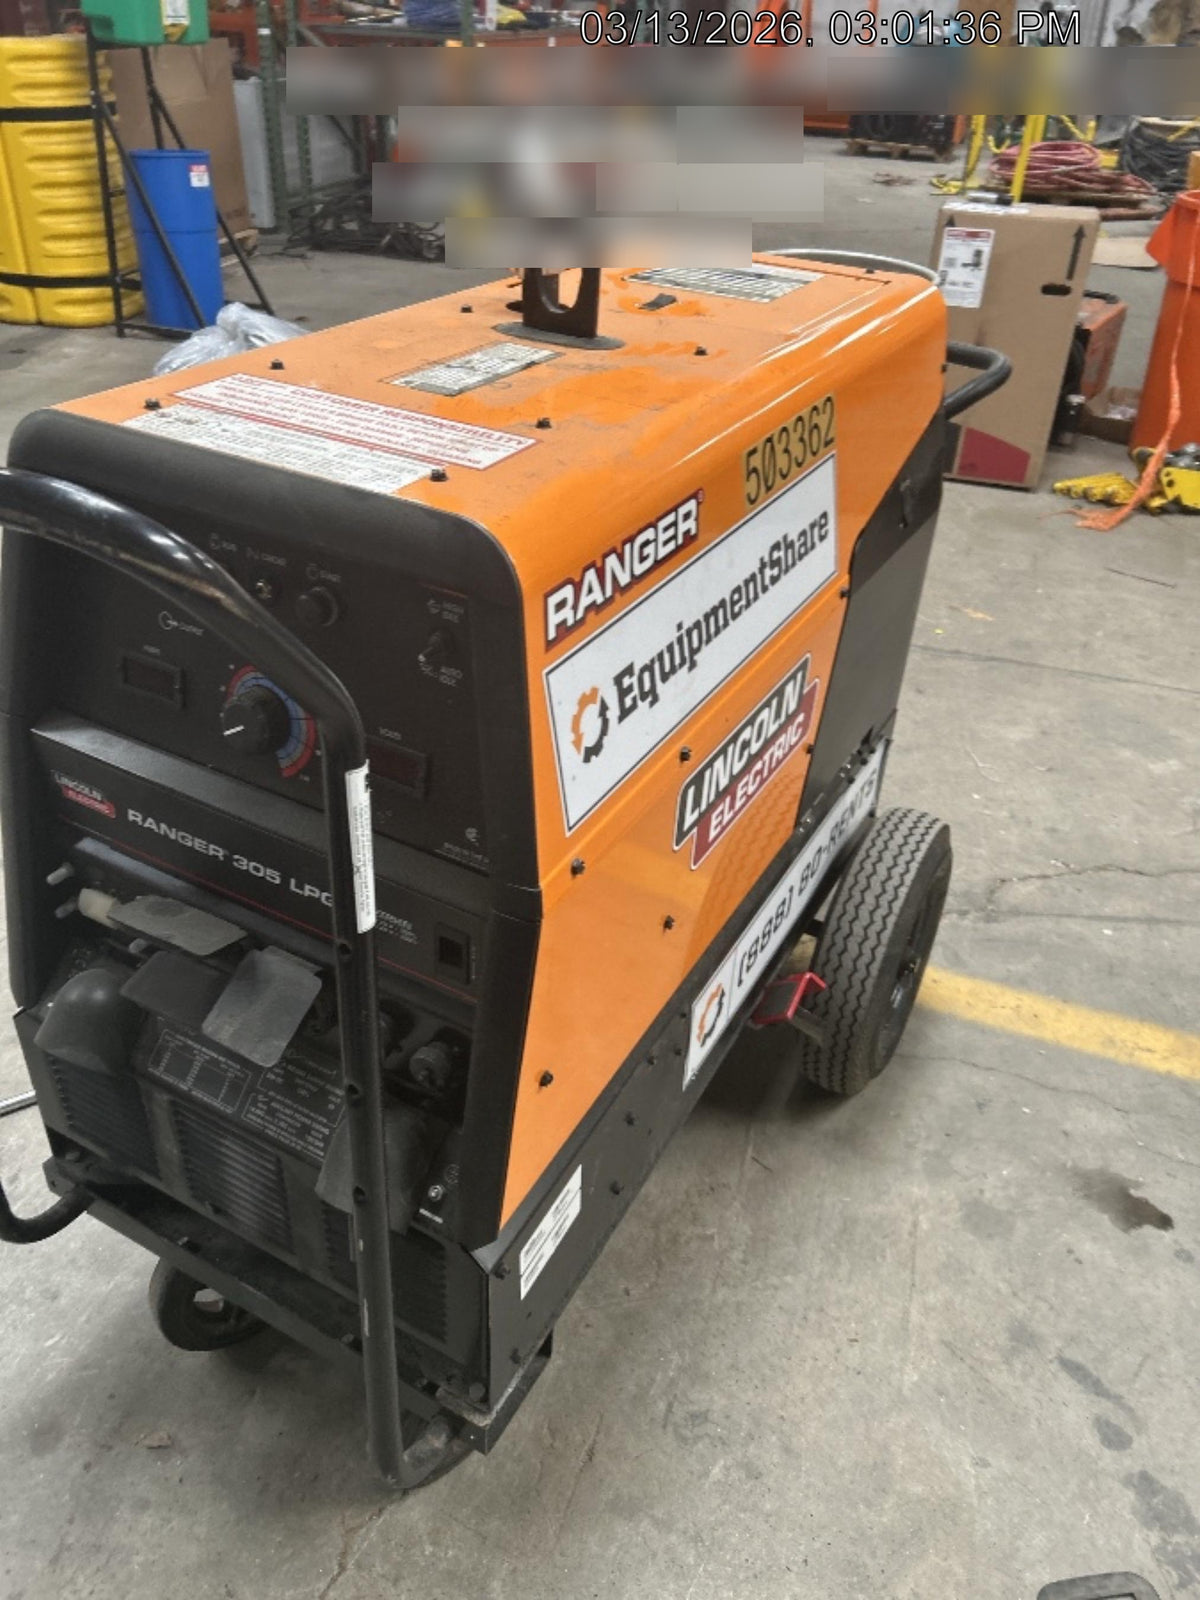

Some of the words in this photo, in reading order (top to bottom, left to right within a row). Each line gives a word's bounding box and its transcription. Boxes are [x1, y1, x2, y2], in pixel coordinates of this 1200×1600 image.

[745, 396, 835, 506] 503362
[546, 498, 699, 641] RANGER
[613, 510, 830, 723] EquipmentShare
[682, 669, 805, 833] LINCOLN
[707, 712, 805, 843] ELECTRIC
[126, 808, 225, 861] RANGER
[231, 854, 282, 885] 305
